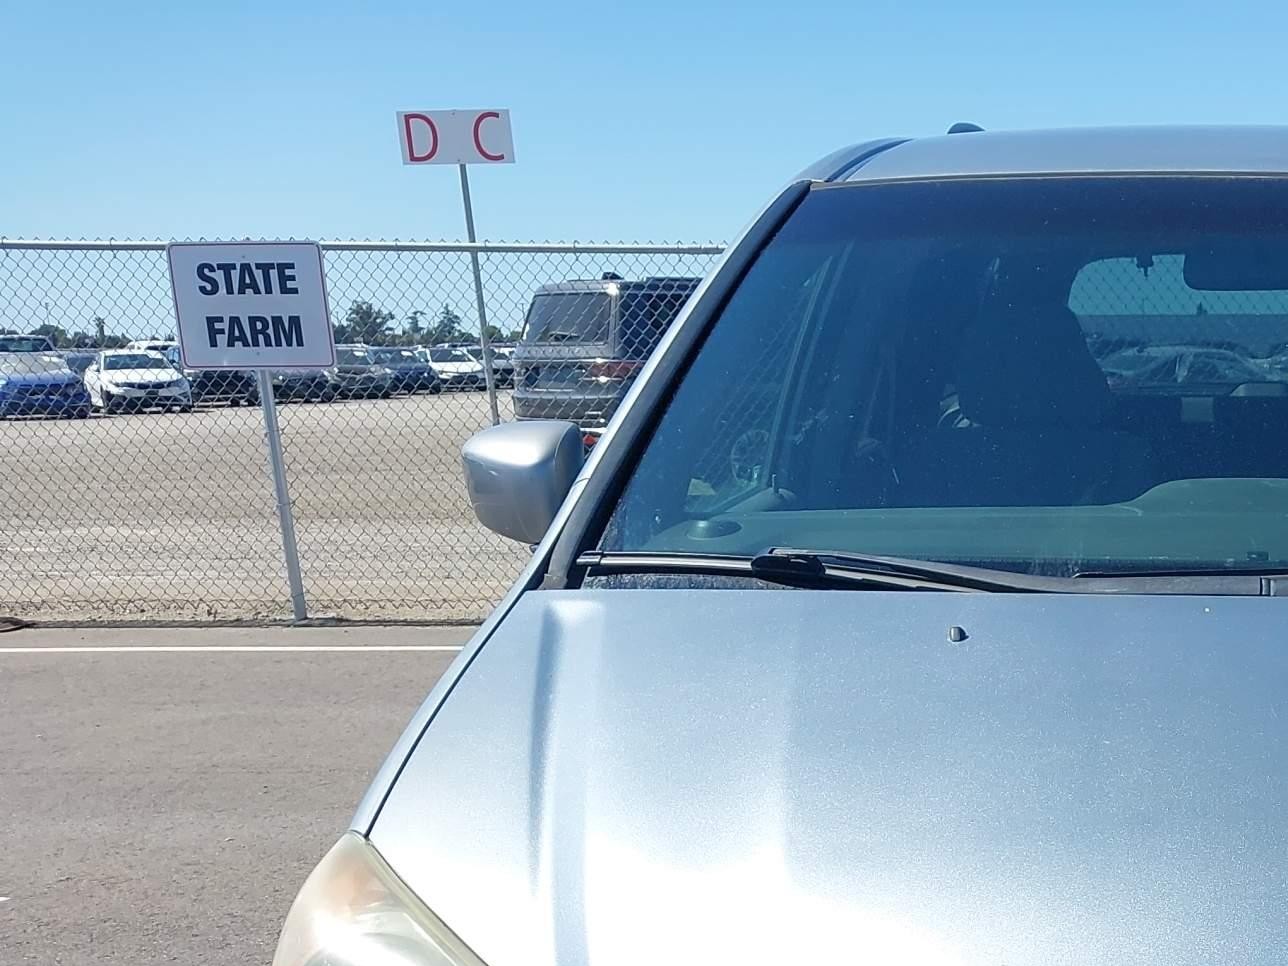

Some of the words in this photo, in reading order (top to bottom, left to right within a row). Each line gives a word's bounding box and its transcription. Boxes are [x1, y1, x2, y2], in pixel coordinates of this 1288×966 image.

[403, 113, 439, 163] D
[473, 111, 505, 162] C
[196, 262, 299, 296] STATE
[205, 315, 305, 349] FARM
